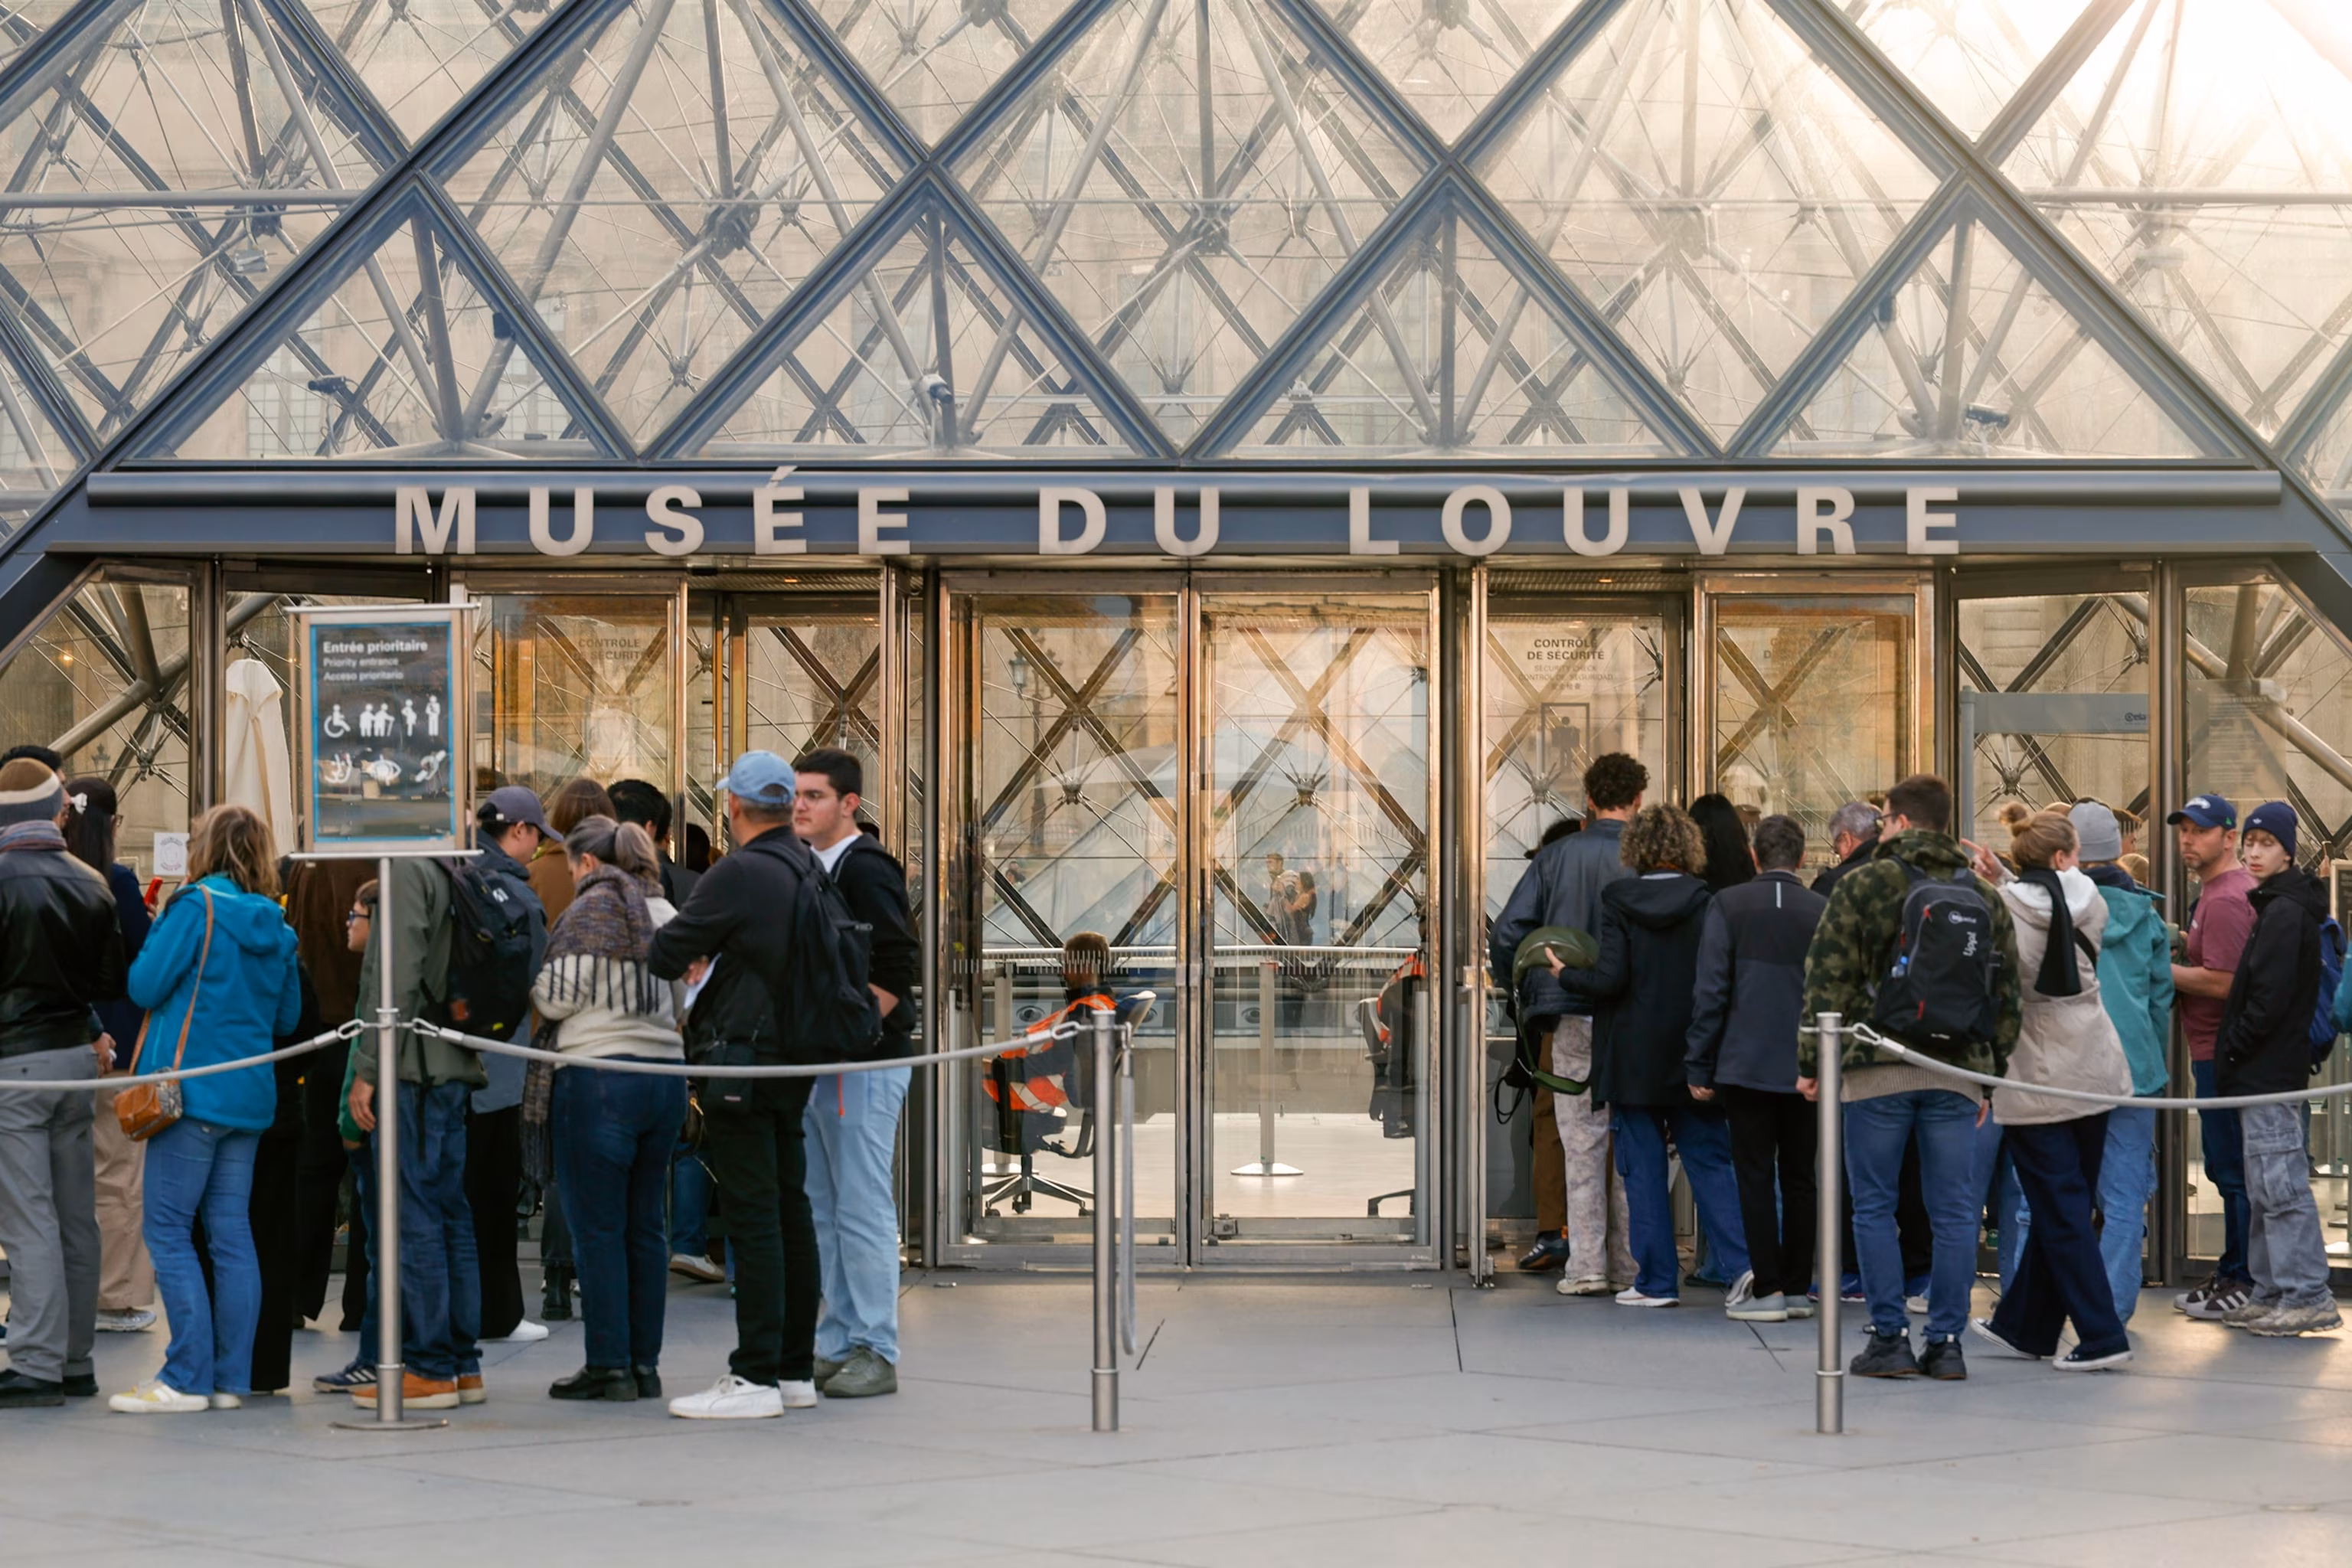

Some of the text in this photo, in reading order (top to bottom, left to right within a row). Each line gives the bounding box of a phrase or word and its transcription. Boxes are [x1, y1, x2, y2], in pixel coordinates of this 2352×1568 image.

[395, 466, 1959, 557] MUSÉE DU LOUVRE
[322, 639, 428, 655] Entrée prioritaire
[578, 637, 641, 648] CONTRÔLE
[1527, 648, 1605, 660] DE SÉCURITÉ
[323, 658, 399, 668] Priority entrance
[323, 669, 404, 681] Acceso prioritario
